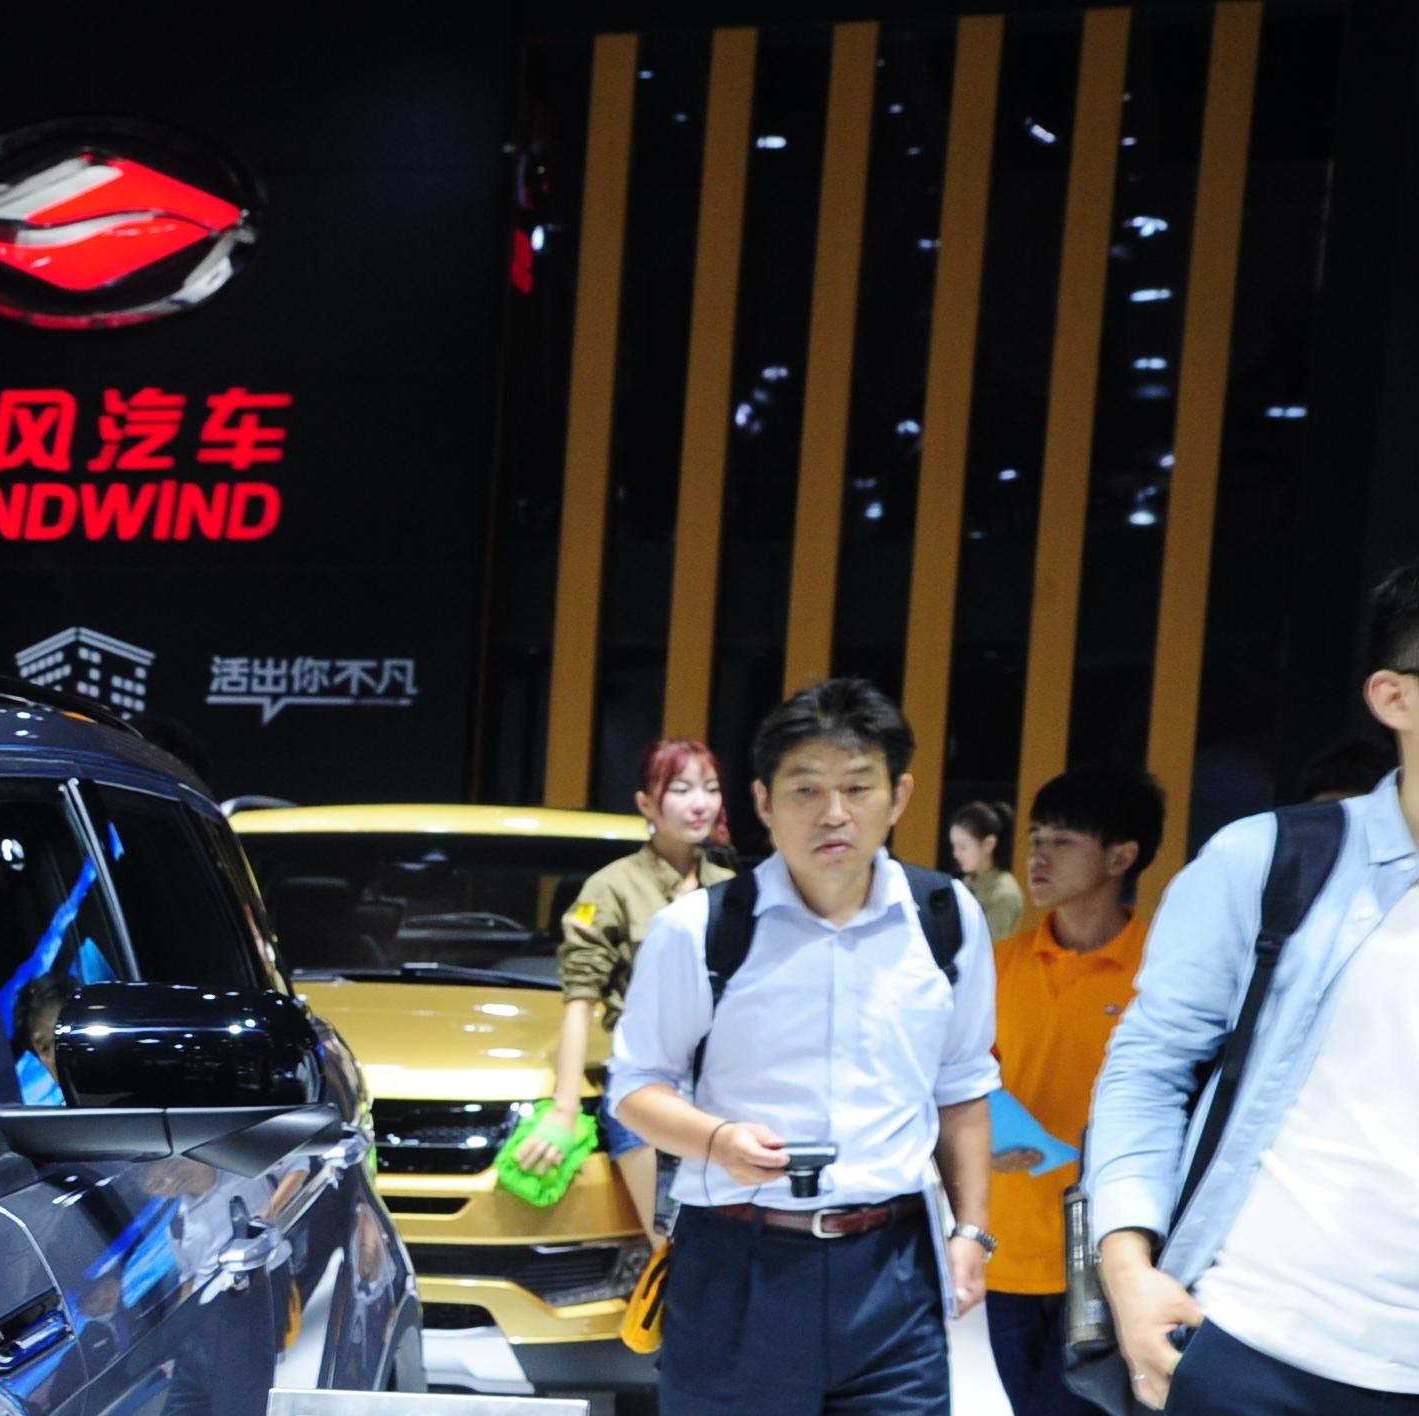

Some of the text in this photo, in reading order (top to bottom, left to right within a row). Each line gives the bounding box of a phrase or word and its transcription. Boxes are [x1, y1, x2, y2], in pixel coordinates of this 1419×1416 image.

[209, 655, 418, 695] 活出你不凡
